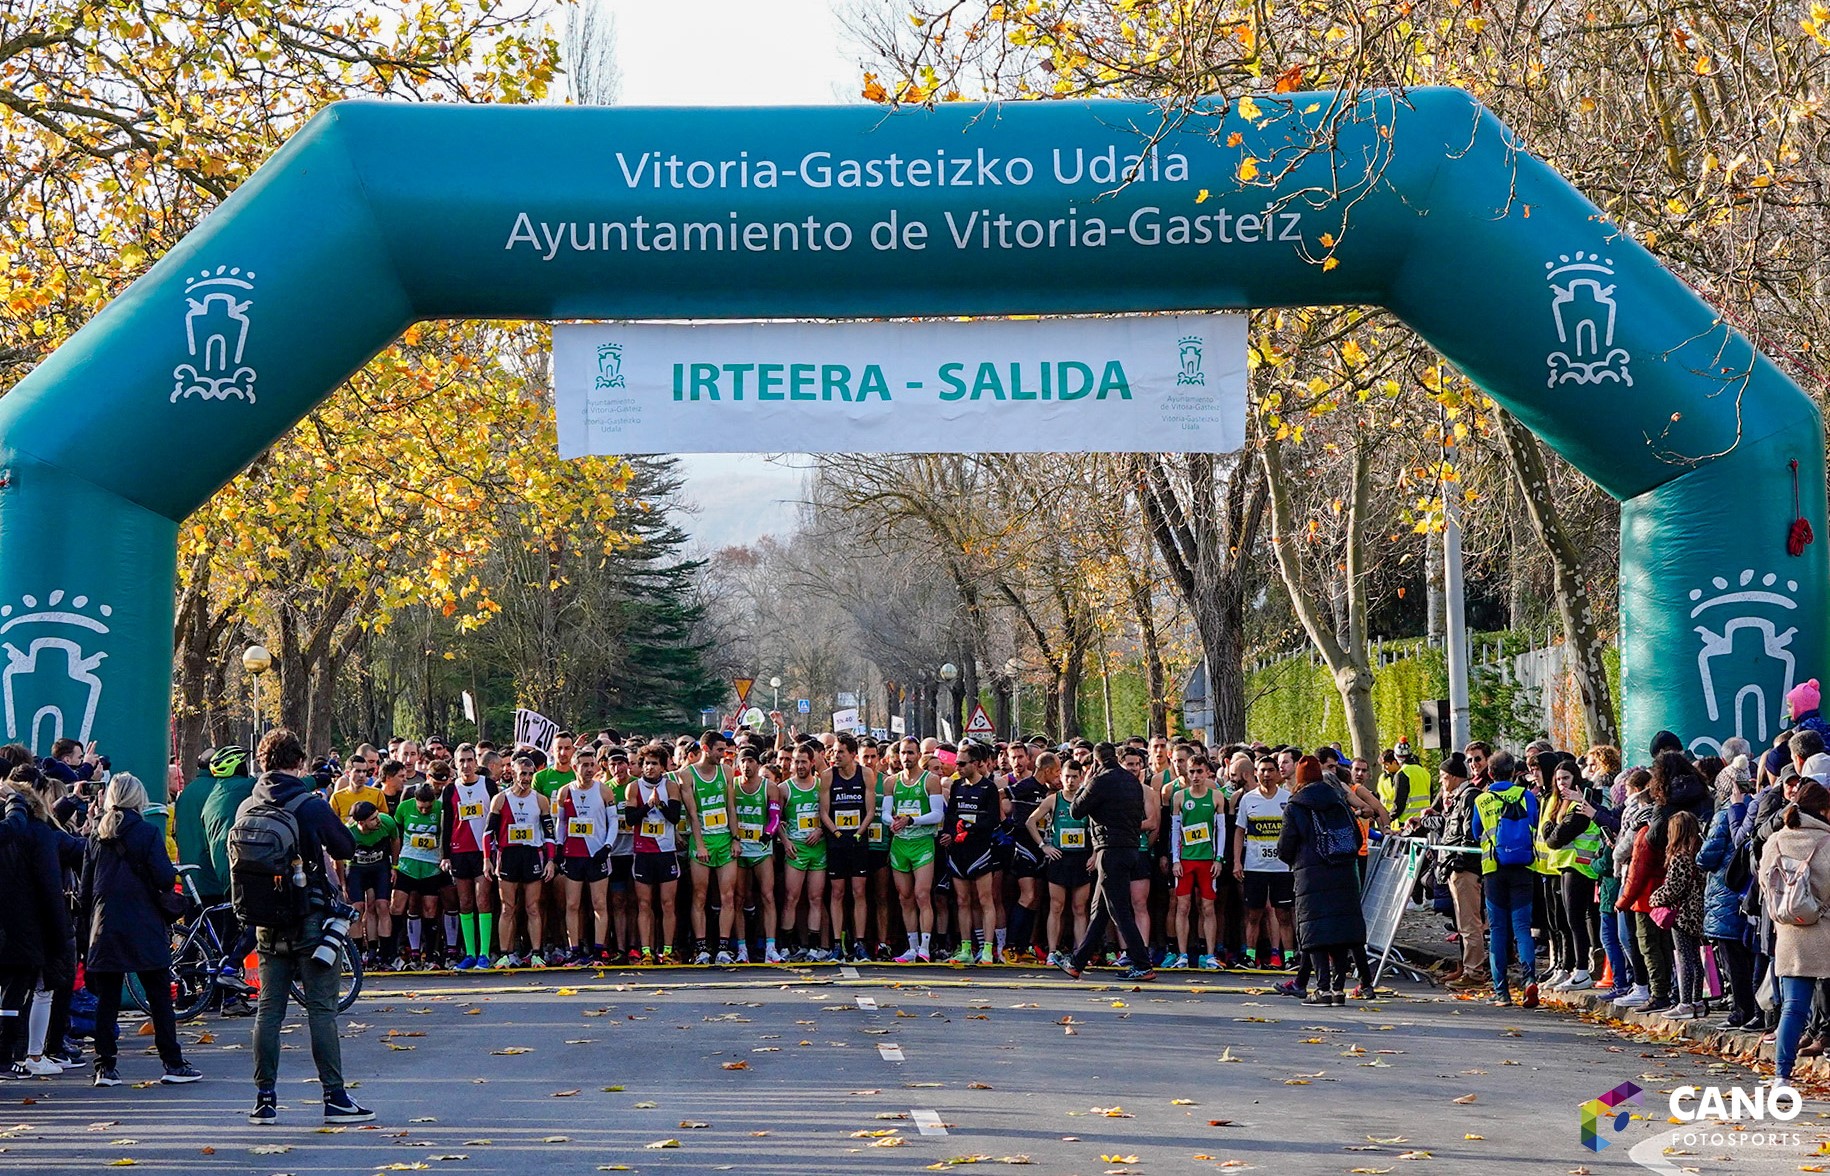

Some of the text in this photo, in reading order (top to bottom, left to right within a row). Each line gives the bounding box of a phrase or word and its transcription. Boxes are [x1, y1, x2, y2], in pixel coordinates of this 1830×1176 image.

[615, 144, 1189, 189] Vitoria-Gasteizko Udala
[504, 202, 1301, 261] Ayuntamiento de Vitoria-Gasteiz
[673, 363, 893, 402] IRTEERA
[938, 360, 1133, 401] SALIDA
[701, 794, 725, 806] LEA
[466, 805, 477, 815] 28
[737, 806, 762, 815] LEA
[714, 815, 718, 824] 1
[807, 819, 813, 828] 3
[843, 816, 853, 826] 21
[407, 823, 438, 833] LEA
[576, 824, 587, 833] 30
[648, 824, 658, 833] 31
[515, 830, 527, 839] 33
[744, 830, 754, 839] 13
[1068, 834, 1079, 843] 93
[1191, 829, 1202, 840] 42
[418, 838, 429, 848] 62
